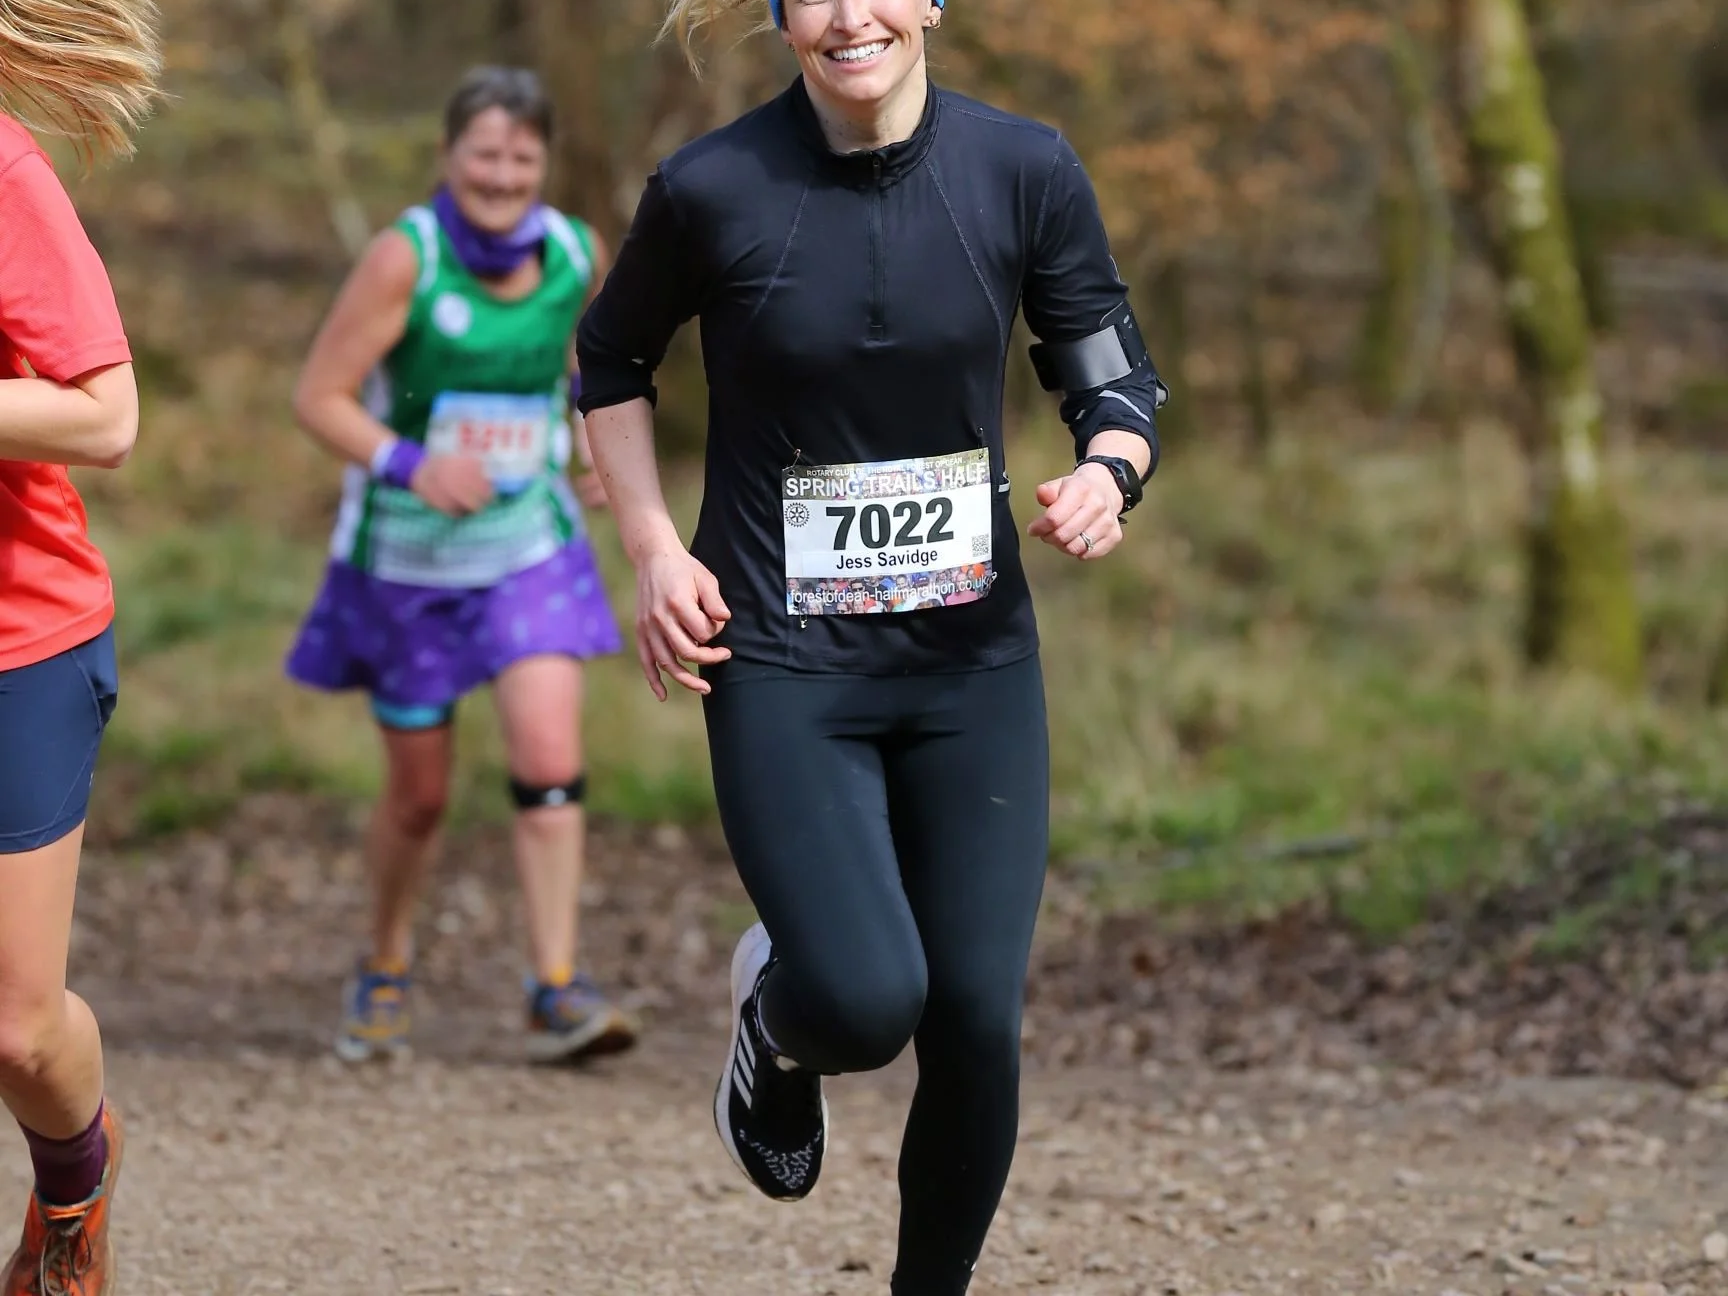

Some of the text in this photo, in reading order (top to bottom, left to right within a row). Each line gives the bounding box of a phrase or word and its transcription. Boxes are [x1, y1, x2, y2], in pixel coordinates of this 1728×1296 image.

[786, 462, 986, 497] SPRING TRAILS HALF
[806, 468, 834, 477] ROTARY
[835, 467, 854, 477] CLUB
[867, 466, 881, 474] THE
[883, 464, 906, 473] ROYAL
[907, 461, 933, 471] FOREST
[945, 457, 963, 466] DEAN
[826, 497, 954, 550] 7022
[836, 549, 938, 570] Jess Savidge
[790, 576, 988, 604] forestofdean-halfmarathon.co.uk
